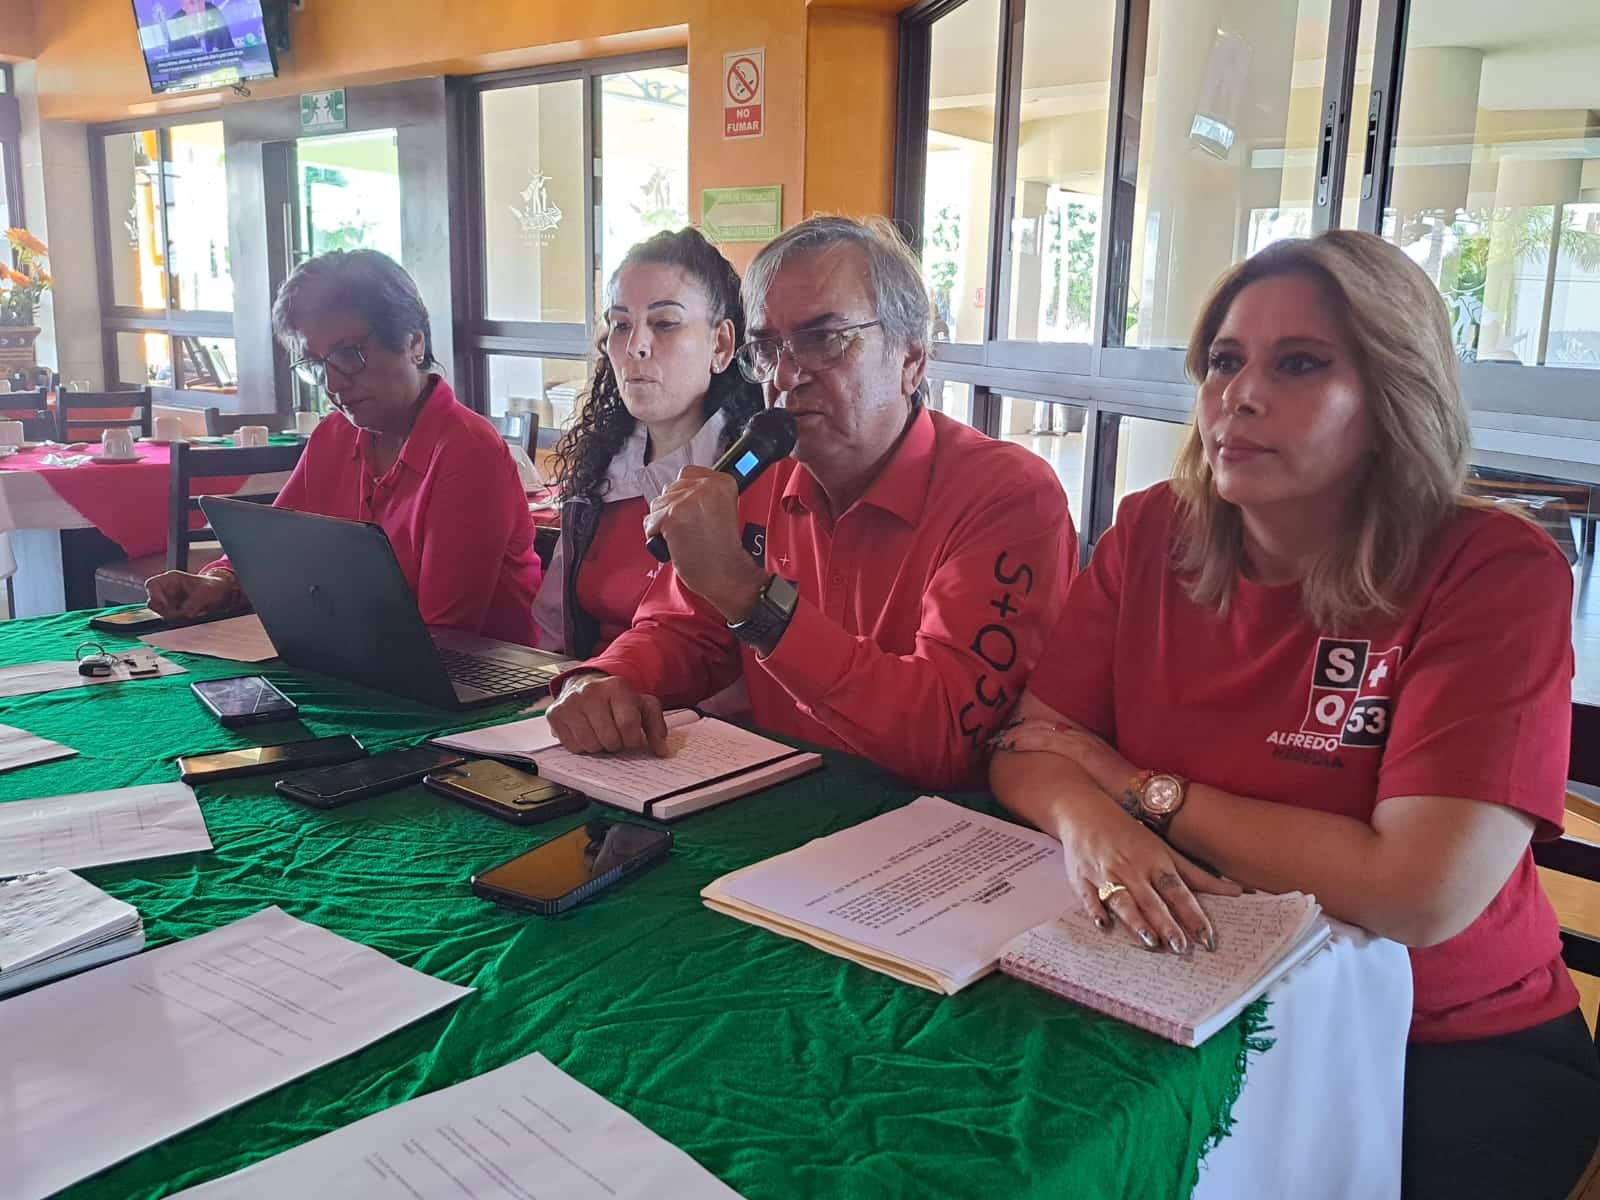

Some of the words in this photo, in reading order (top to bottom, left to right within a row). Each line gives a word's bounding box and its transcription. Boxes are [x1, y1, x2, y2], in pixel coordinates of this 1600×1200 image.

[736, 108, 750, 119] NO
[727, 120, 760, 132] FUMAR
[752, 534, 764, 556] S
[1325, 647, 1356, 683] S
[1315, 694, 1346, 726] Q
[1346, 706, 1386, 734] 53
[1266, 731, 1338, 752] ALFREDO
